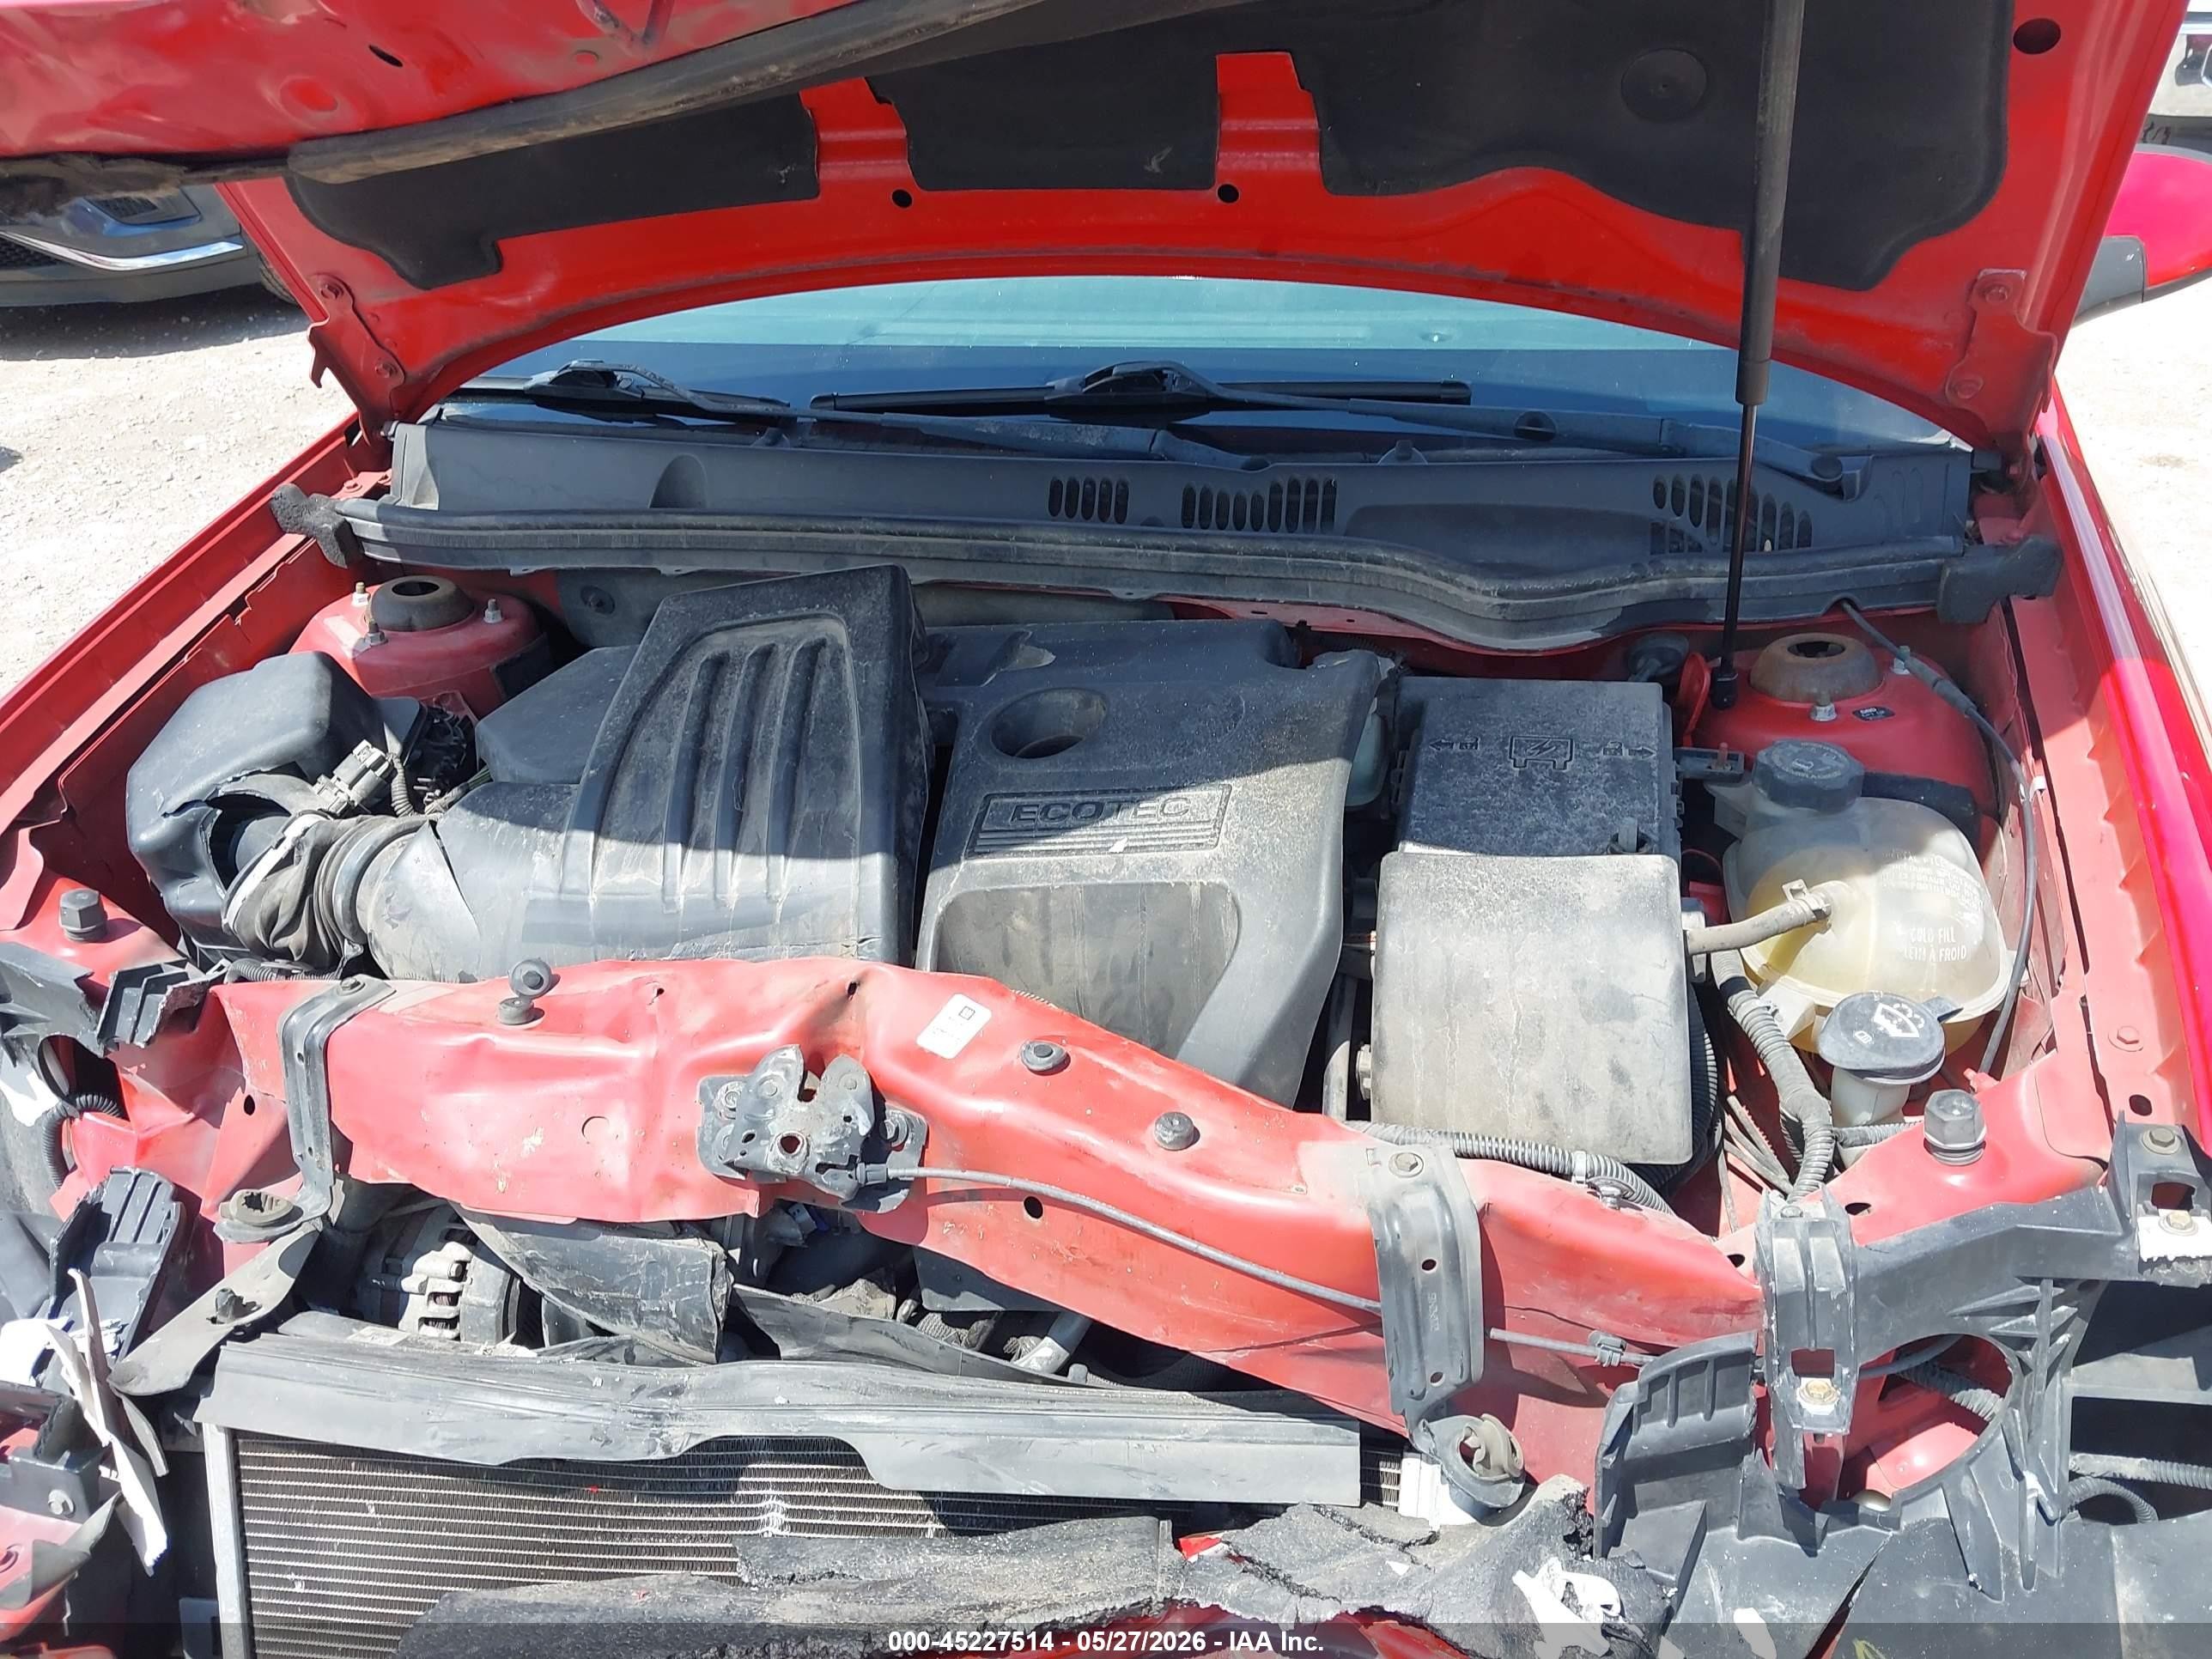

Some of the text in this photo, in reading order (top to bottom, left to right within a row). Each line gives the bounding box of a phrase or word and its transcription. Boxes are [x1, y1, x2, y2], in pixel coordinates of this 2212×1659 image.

[1009, 797, 1191, 824] ECOTEC
[1938, 926, 1957, 944] FILL
[1938, 945, 1967, 962] FROID
